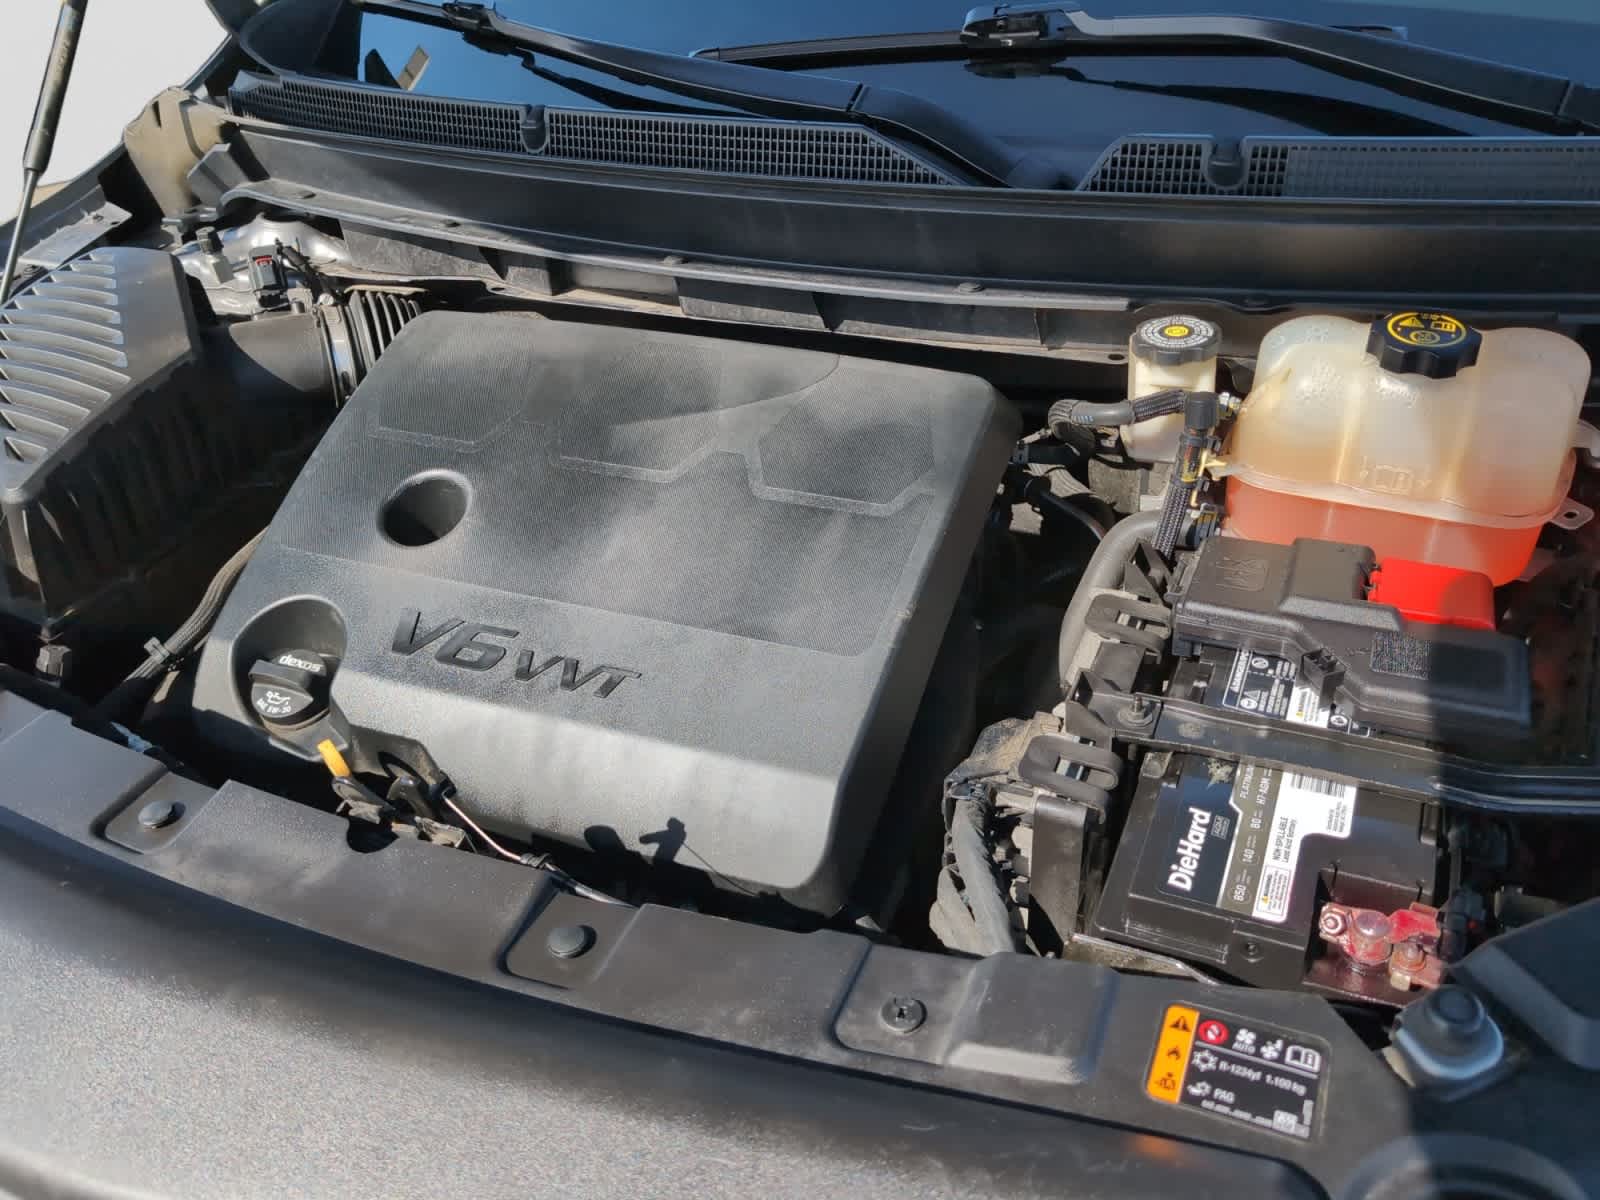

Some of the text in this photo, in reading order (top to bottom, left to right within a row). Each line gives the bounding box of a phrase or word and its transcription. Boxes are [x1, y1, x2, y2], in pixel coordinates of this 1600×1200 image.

[279, 654, 323, 672] dexos
[391, 611, 642, 698] V6 VVT
[1250, 817, 1262, 829] 80
[1168, 807, 1211, 891] DieHard
[1242, 849, 1255, 863] 140
[1233, 884, 1247, 901] 850
[1232, 1041, 1255, 1054] AUTO
[1218, 1061, 1262, 1081] R-1234yf
[1213, 1087, 1235, 1104] PAG
